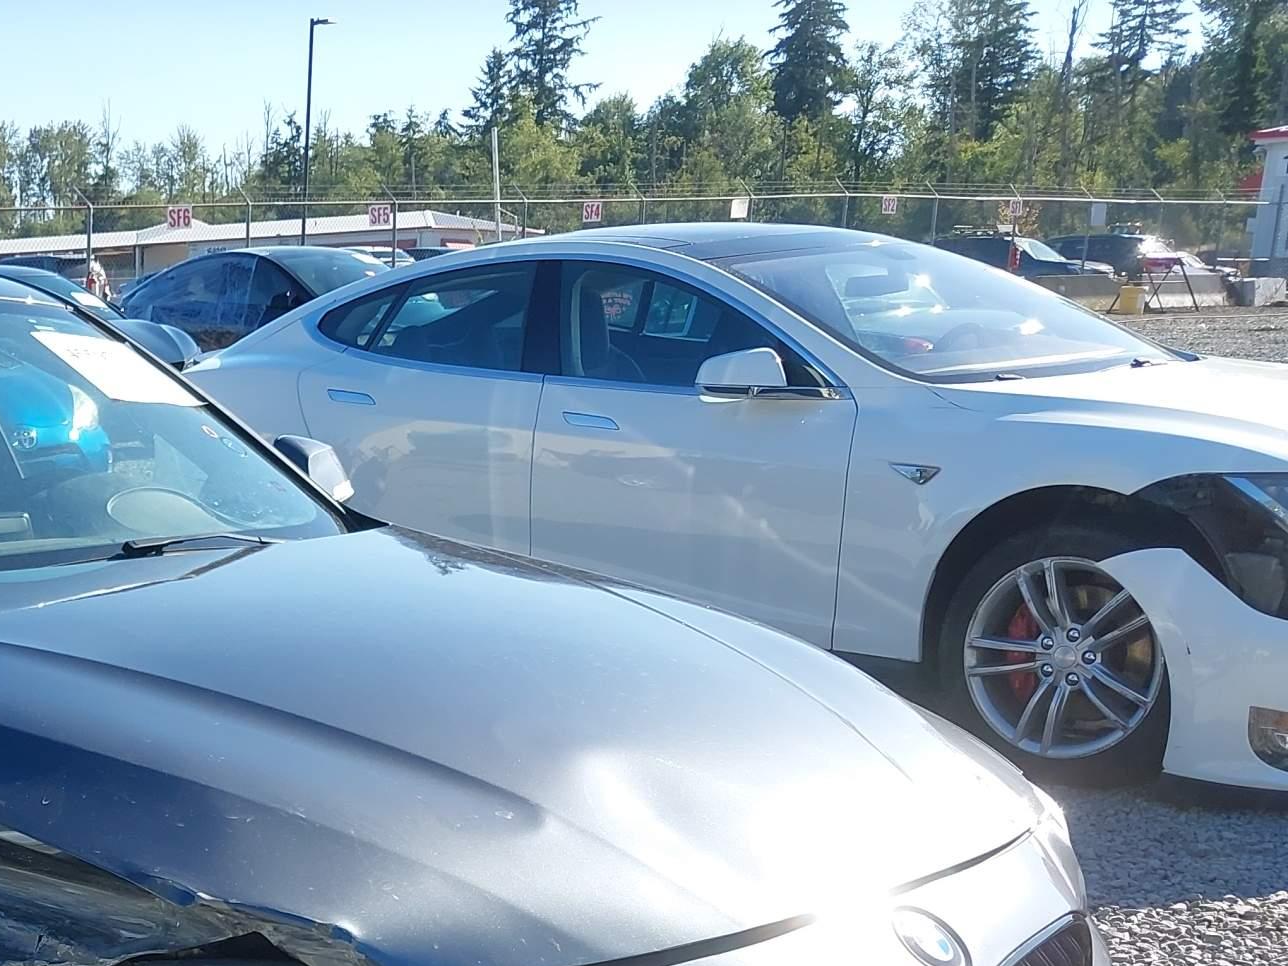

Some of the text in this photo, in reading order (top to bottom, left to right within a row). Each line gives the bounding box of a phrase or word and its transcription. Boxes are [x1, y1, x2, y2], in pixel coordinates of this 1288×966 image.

[584, 203, 600, 220] SF4
[884, 198, 895, 213] SF2
[169, 208, 191, 228] SF6
[370, 206, 390, 225] SF5
